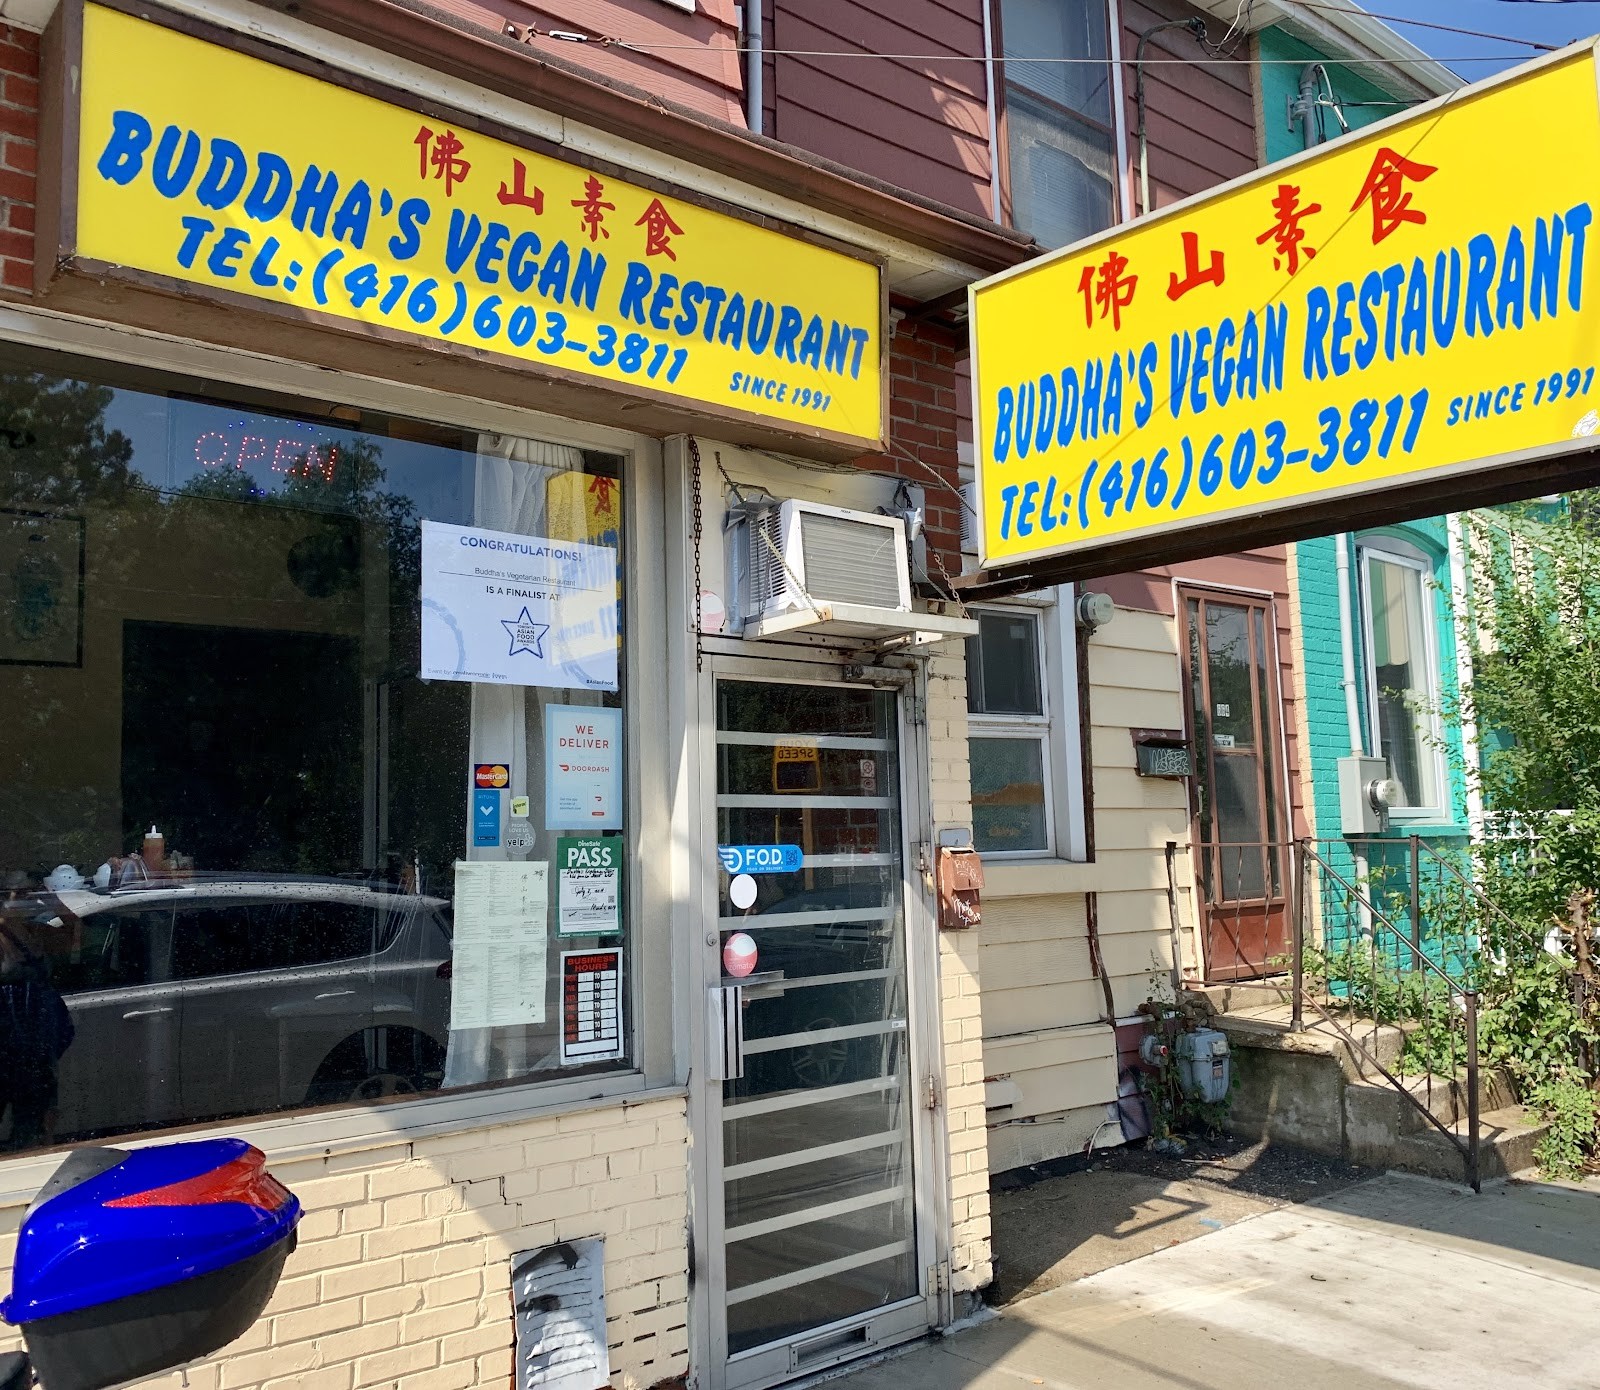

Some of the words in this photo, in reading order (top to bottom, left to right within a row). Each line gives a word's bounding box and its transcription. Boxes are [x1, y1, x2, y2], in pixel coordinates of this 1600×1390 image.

[414, 127, 682, 260] 佛山素食
[98, 111, 431, 260] BUDDHA'S
[446, 210, 607, 311] VEGAN
[620, 263, 868, 378] RESTAURANT
[1077, 147, 1437, 331] 佛山素食
[993, 342, 1157, 463] BUDDHA'S
[1170, 303, 1288, 418] VEGAN
[1303, 203, 1592, 380] RESTAURANT
[729, 372, 788, 402] SINCE
[791, 387, 831, 412] 1991
[1446, 382, 1526, 426] SINCE
[1533, 366, 1595, 406] 1991
[195, 432, 338, 481] OPEN
[460, 536, 582, 562] CONGRATULATIONS!
[474, 567, 505, 578] Buddha's
[507, 571, 541, 582] Vegetarian
[542, 575, 576, 587] Restaurant
[486, 585, 495, 594] IS
[497, 587, 504, 595] A
[506, 588, 547, 600] FINALIST
[549, 593, 560, 601] AT
[575, 725, 594, 735] WE
[559, 738, 610, 749] DELIVER
[572, 765, 610, 773] DOORDASH
[507, 837, 525, 847] yelp
[567, 847, 612, 867] PASS
[746, 848, 784, 865] F.O.D.
[567, 955, 616, 965] BUSINESS
[574, 963, 609, 971] HOURS
[729, 962, 754, 971] zomato
